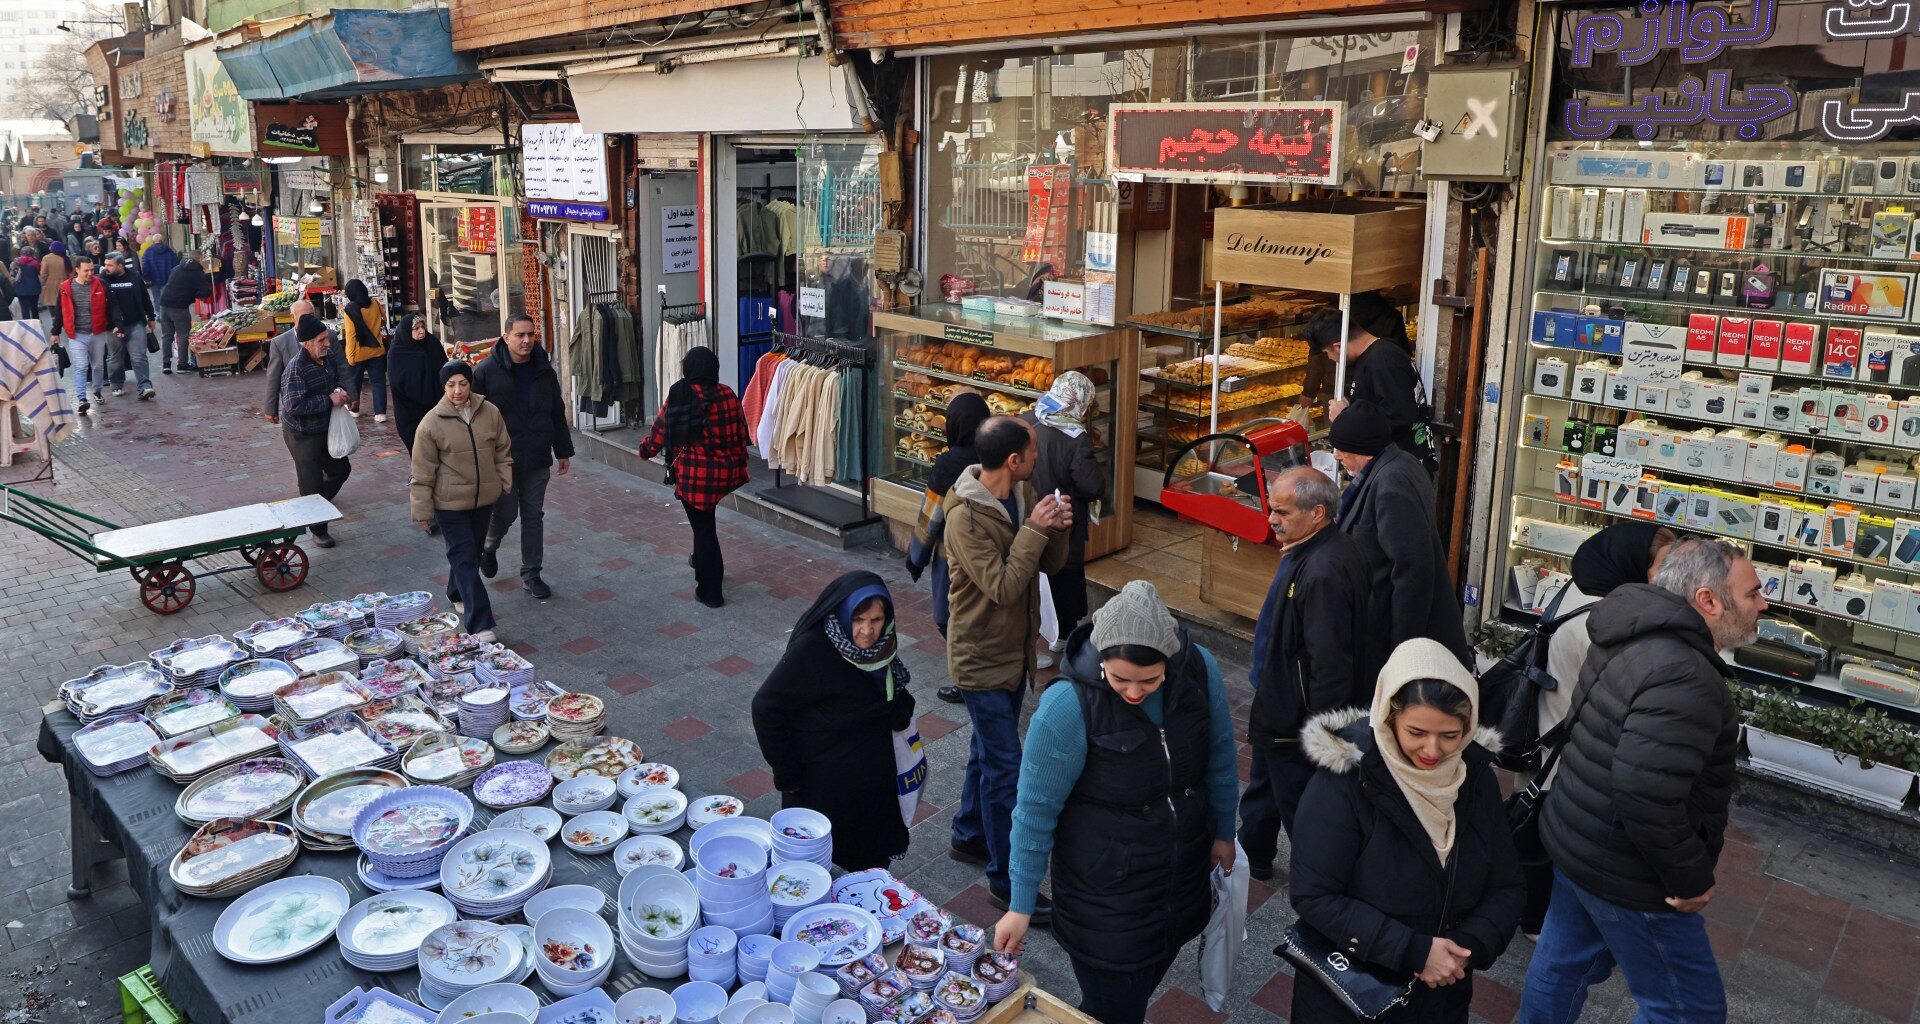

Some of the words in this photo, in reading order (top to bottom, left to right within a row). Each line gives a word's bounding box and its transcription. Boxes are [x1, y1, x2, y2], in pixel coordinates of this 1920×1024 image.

[1573, 0, 1774, 66] لوازم
[1565, 72, 1792, 139] جانبی
[1159, 128, 1239, 163] حجیم
[1248, 119, 1313, 166] نیمه
[667, 209, 679, 220] اول
[679, 208, 695, 218] طبقه
[681, 248, 693, 256] شلوار
[1226, 232, 1337, 266] Delimanjo
[1047, 289, 1070, 299] فروشنده
[1069, 306, 1082, 315] خانم
[1824, 301, 1857, 312] Redmi
[1860, 304, 1882, 313] Pad
[1689, 328, 1714, 336] REDMI
[1721, 331, 1746, 339] REDMI
[1753, 334, 1778, 342] REDMI
[1786, 338, 1811, 346] REDMI
[1828, 343, 1857, 358] 14C
[1628, 350, 1658, 368] ویترین
[1660, 369, 1681, 379] توقف
